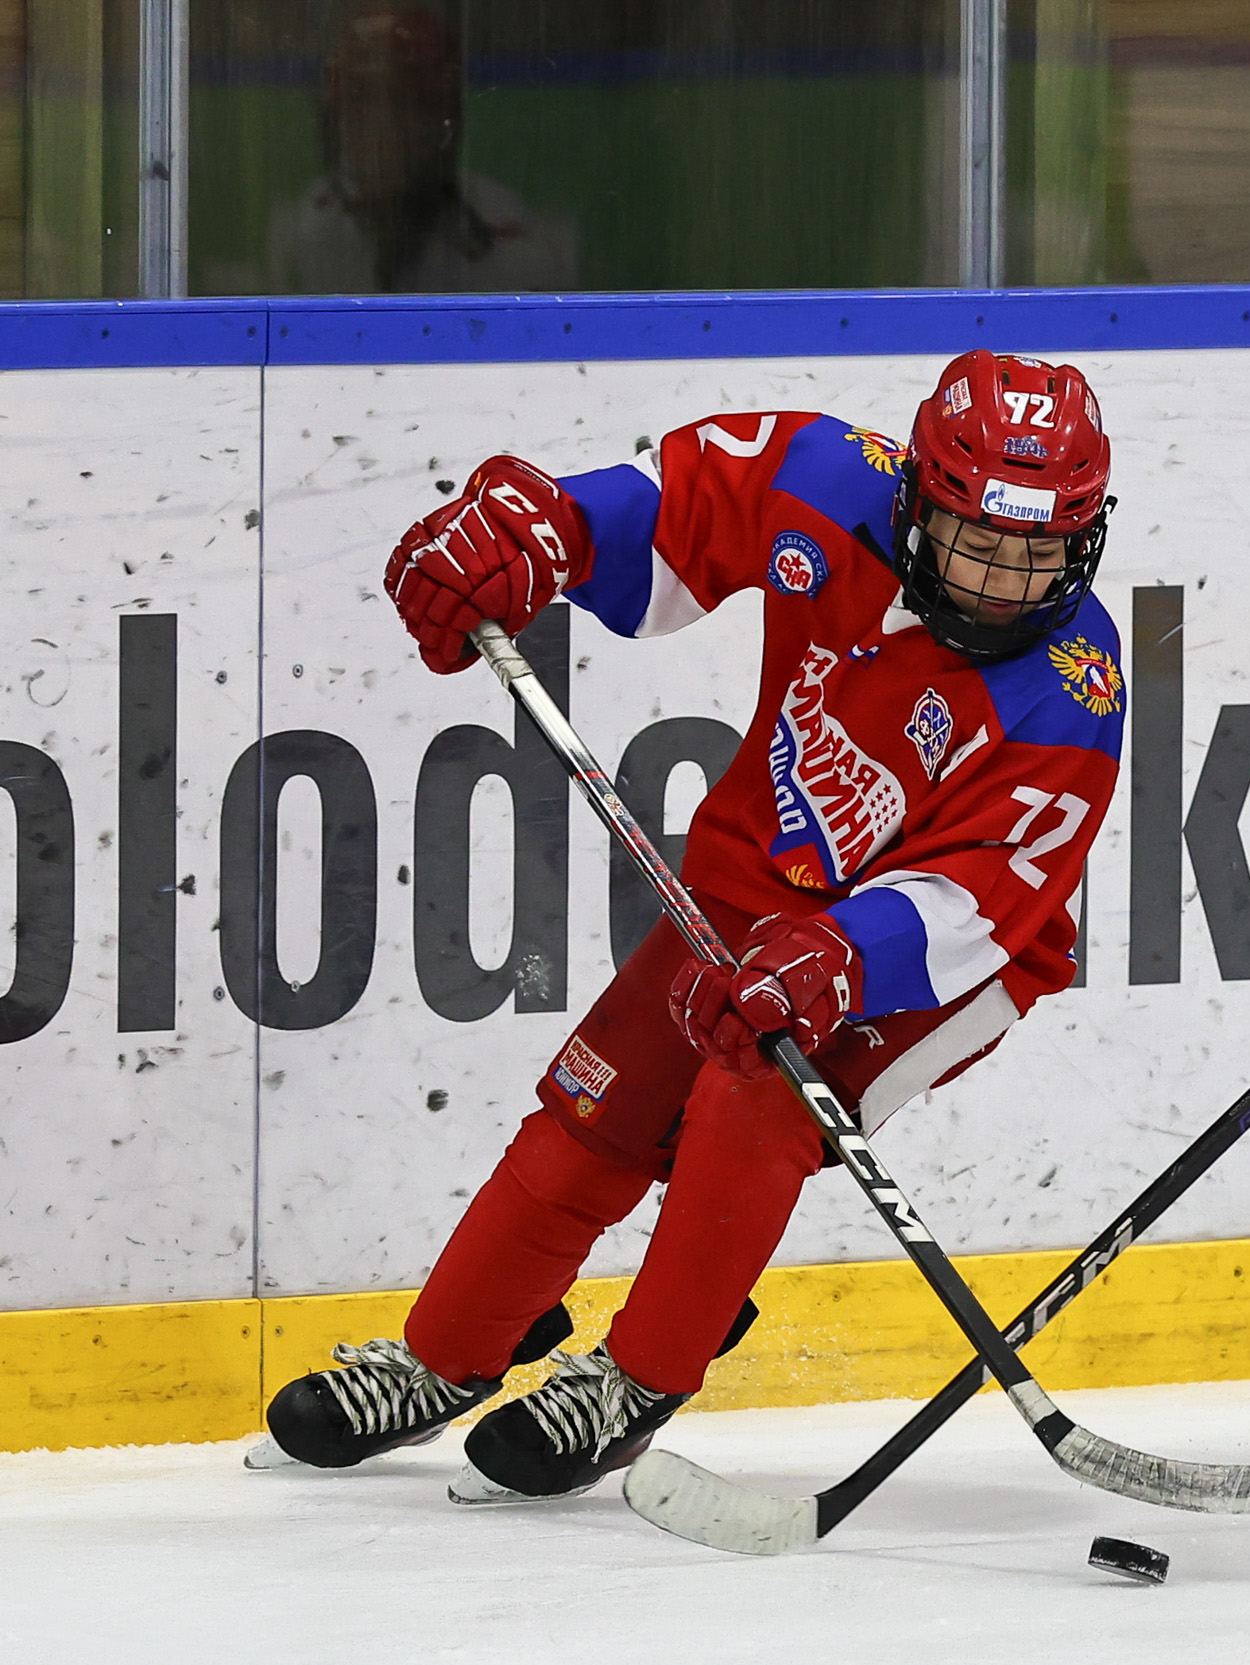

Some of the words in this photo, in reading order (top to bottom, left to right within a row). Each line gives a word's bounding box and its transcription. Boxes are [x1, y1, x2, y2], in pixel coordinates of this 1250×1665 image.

[1002, 502, 1050, 522] ГАЗПРОМ
[1008, 785, 1092, 891] 72
[561, 1049, 605, 1096] МАШИНА
[801, 1082, 936, 1243] CCM
